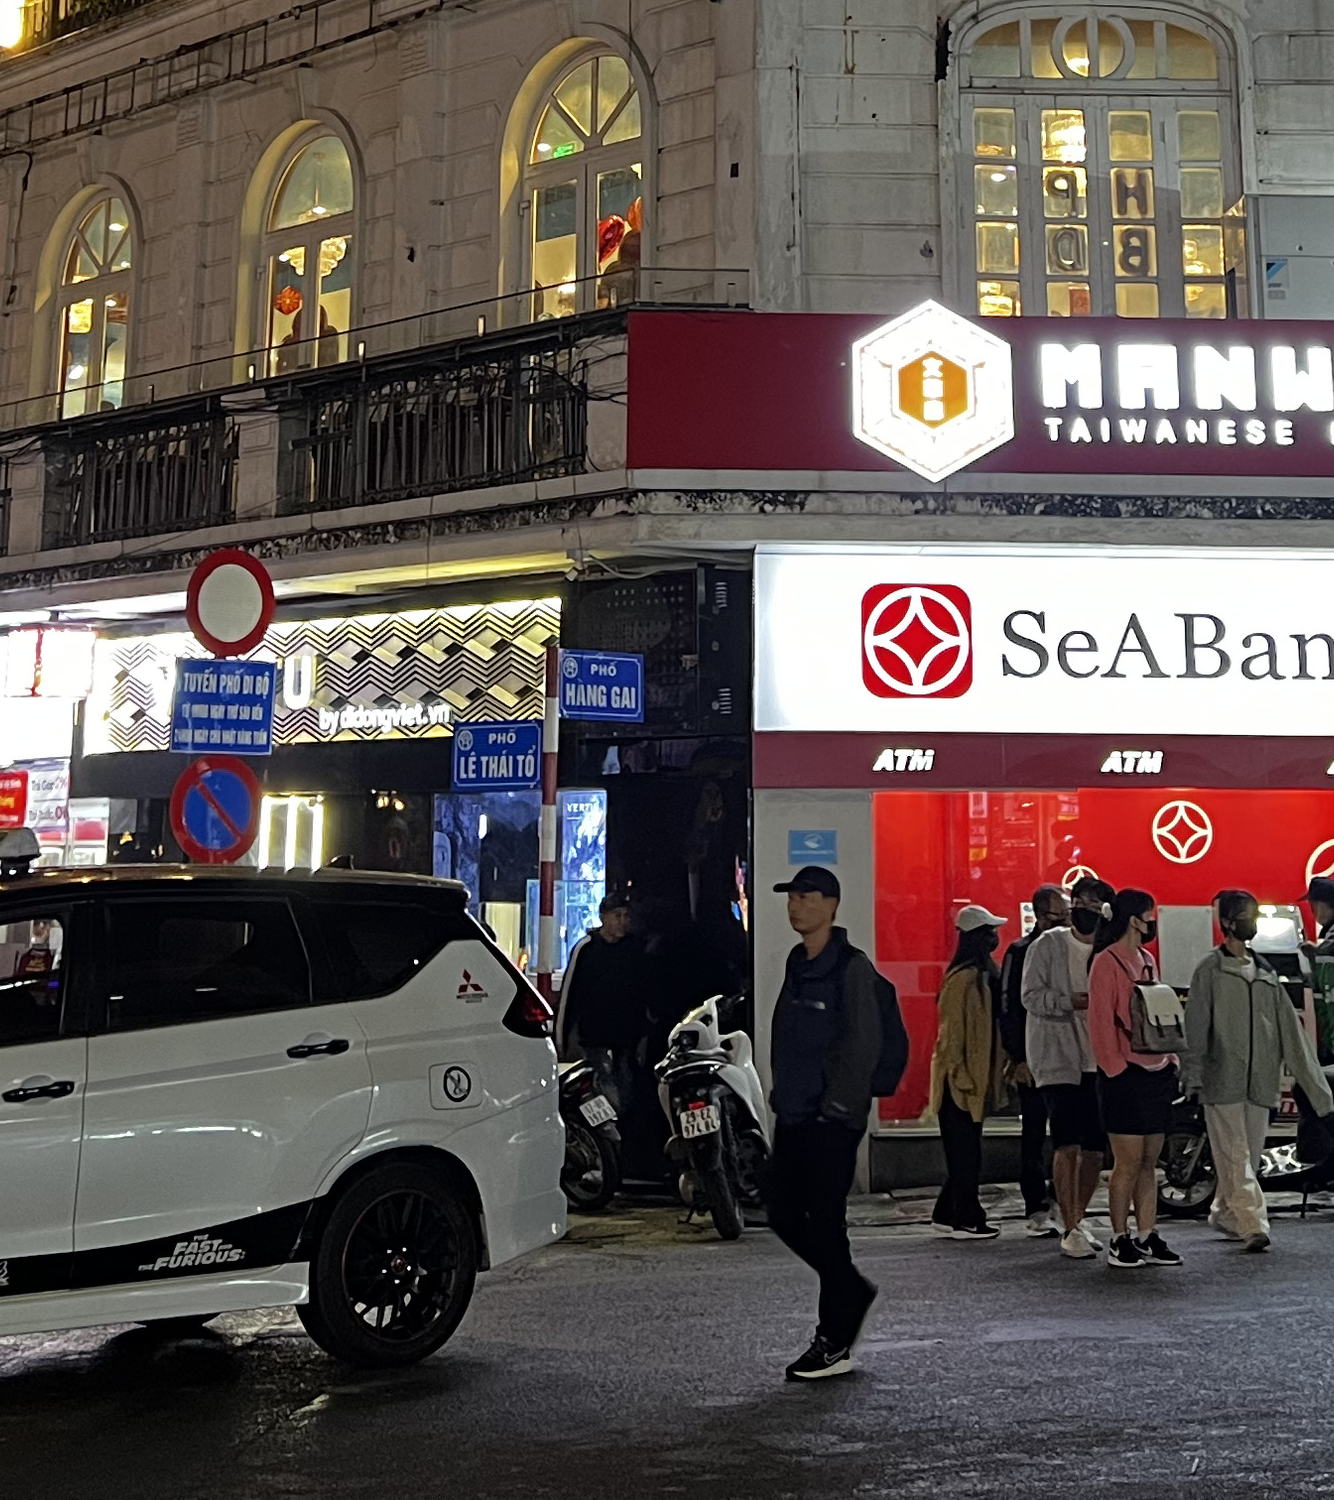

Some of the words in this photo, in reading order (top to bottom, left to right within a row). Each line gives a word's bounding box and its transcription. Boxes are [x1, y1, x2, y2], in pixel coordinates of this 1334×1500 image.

[1044, 418, 1294, 446] TAIWANESE
[590, 661, 617, 677] PHỐ
[184, 667, 217, 693] TUYẾN
[219, 668, 244, 694] PHỐ
[243, 675, 253, 694] DI
[255, 671, 270, 699] BỘ
[565, 679, 607, 707] HÀNG
[611, 684, 636, 709] GAI
[319, 706, 340, 735] by
[340, 702, 451, 733] didongviet.vn
[488, 729, 517, 744] PHỐ
[460, 752, 476, 779] LÊ
[481, 750, 513, 778] THÁI
[517, 745, 536, 778] TỔ
[873, 749, 934, 772] ATM
[1100, 750, 1163, 774] ATM
[173, 1239, 223, 1256] FAST
[154, 1249, 243, 1271] FURIOUS
